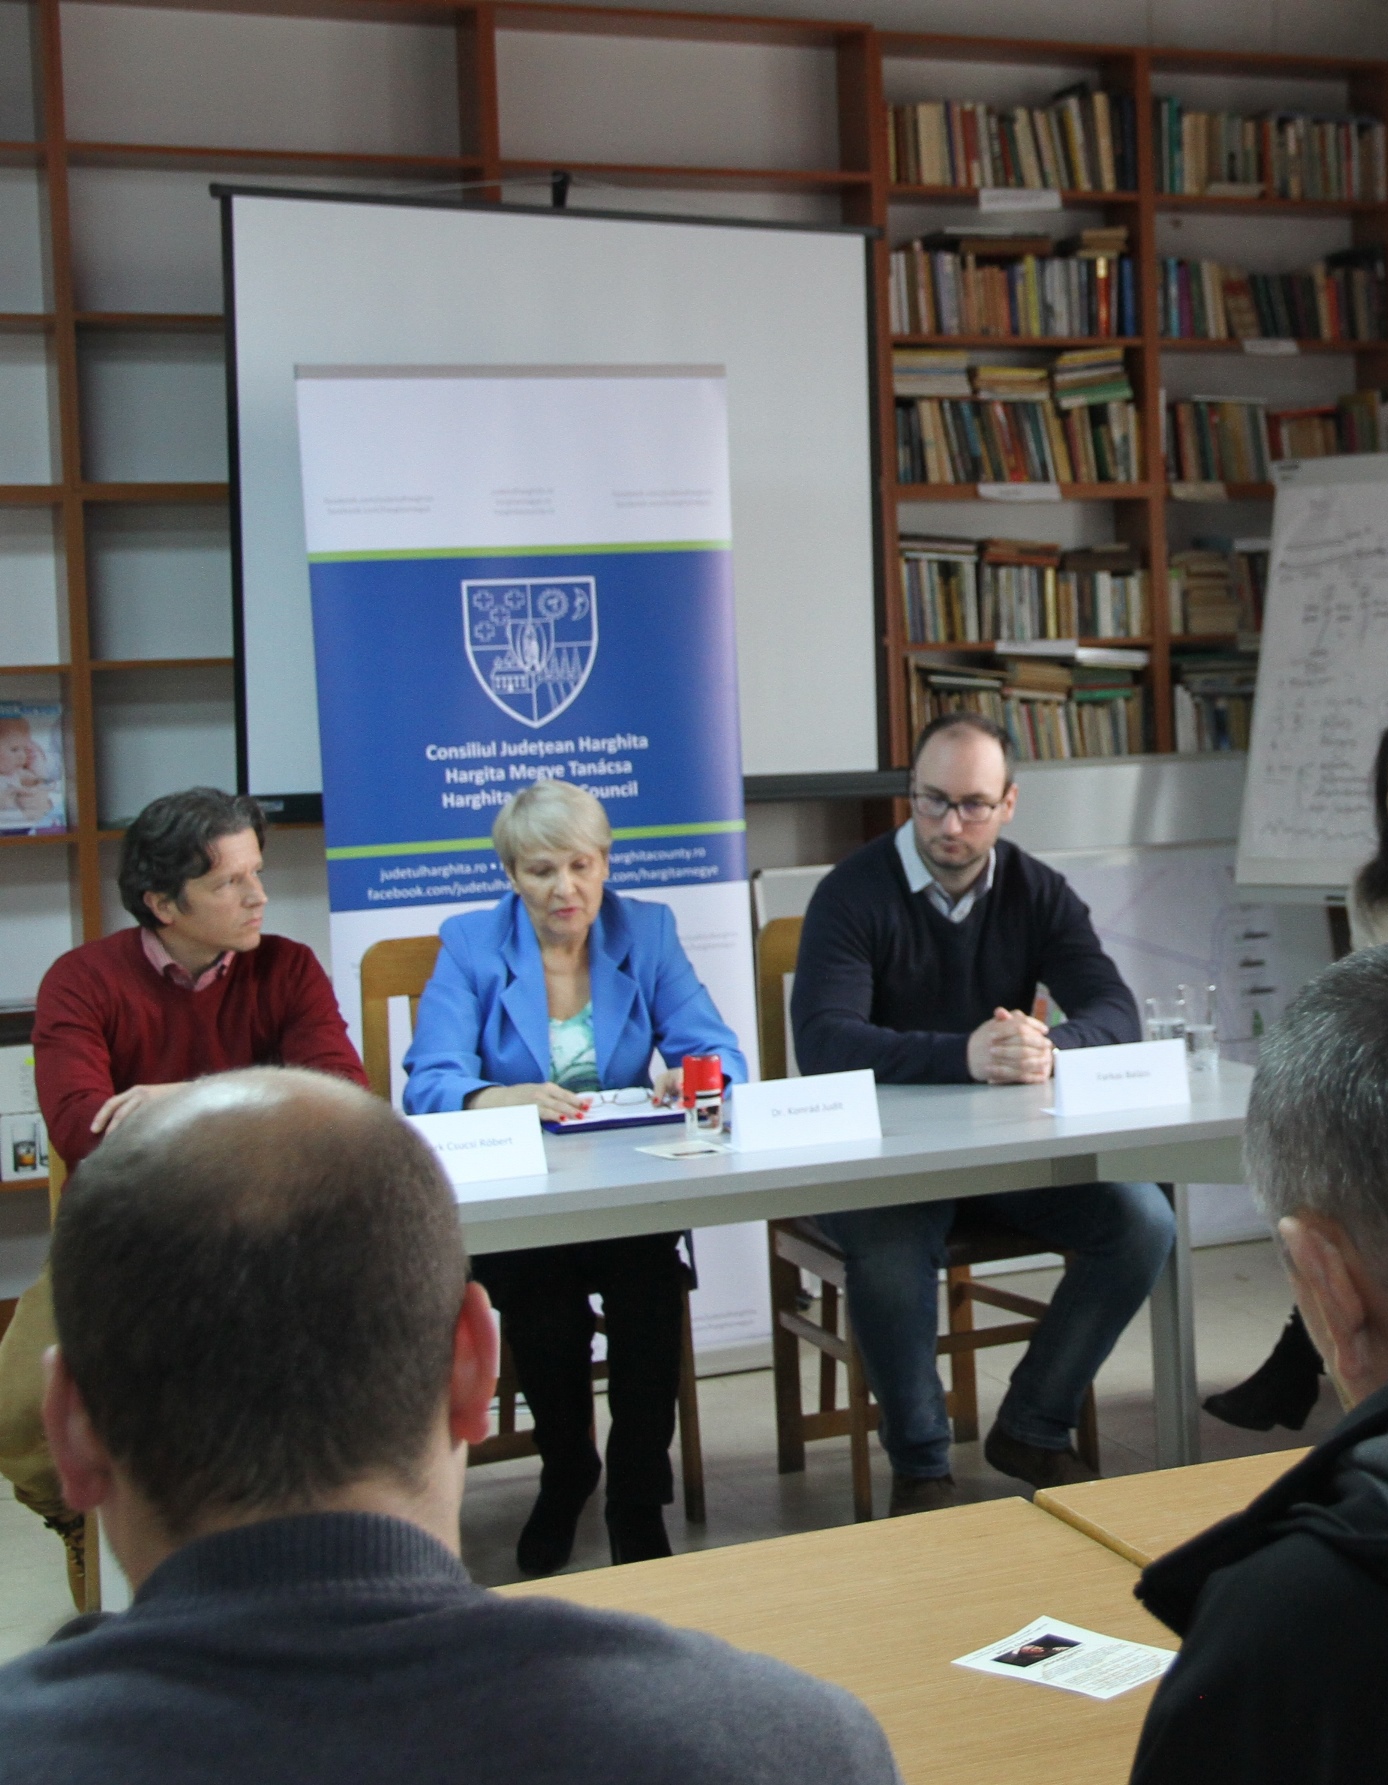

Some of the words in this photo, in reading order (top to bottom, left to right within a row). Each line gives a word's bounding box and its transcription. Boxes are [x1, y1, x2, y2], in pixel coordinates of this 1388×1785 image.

[426, 741, 497, 760] Consiliul
[578, 733, 648, 754] Harghita
[445, 766, 505, 785] Hargita
[509, 763, 565, 781] Megye
[567, 758, 632, 776] Tanácsa
[442, 789, 513, 810] Harghita
[367, 879, 512, 900] facebook.com/judetulha
